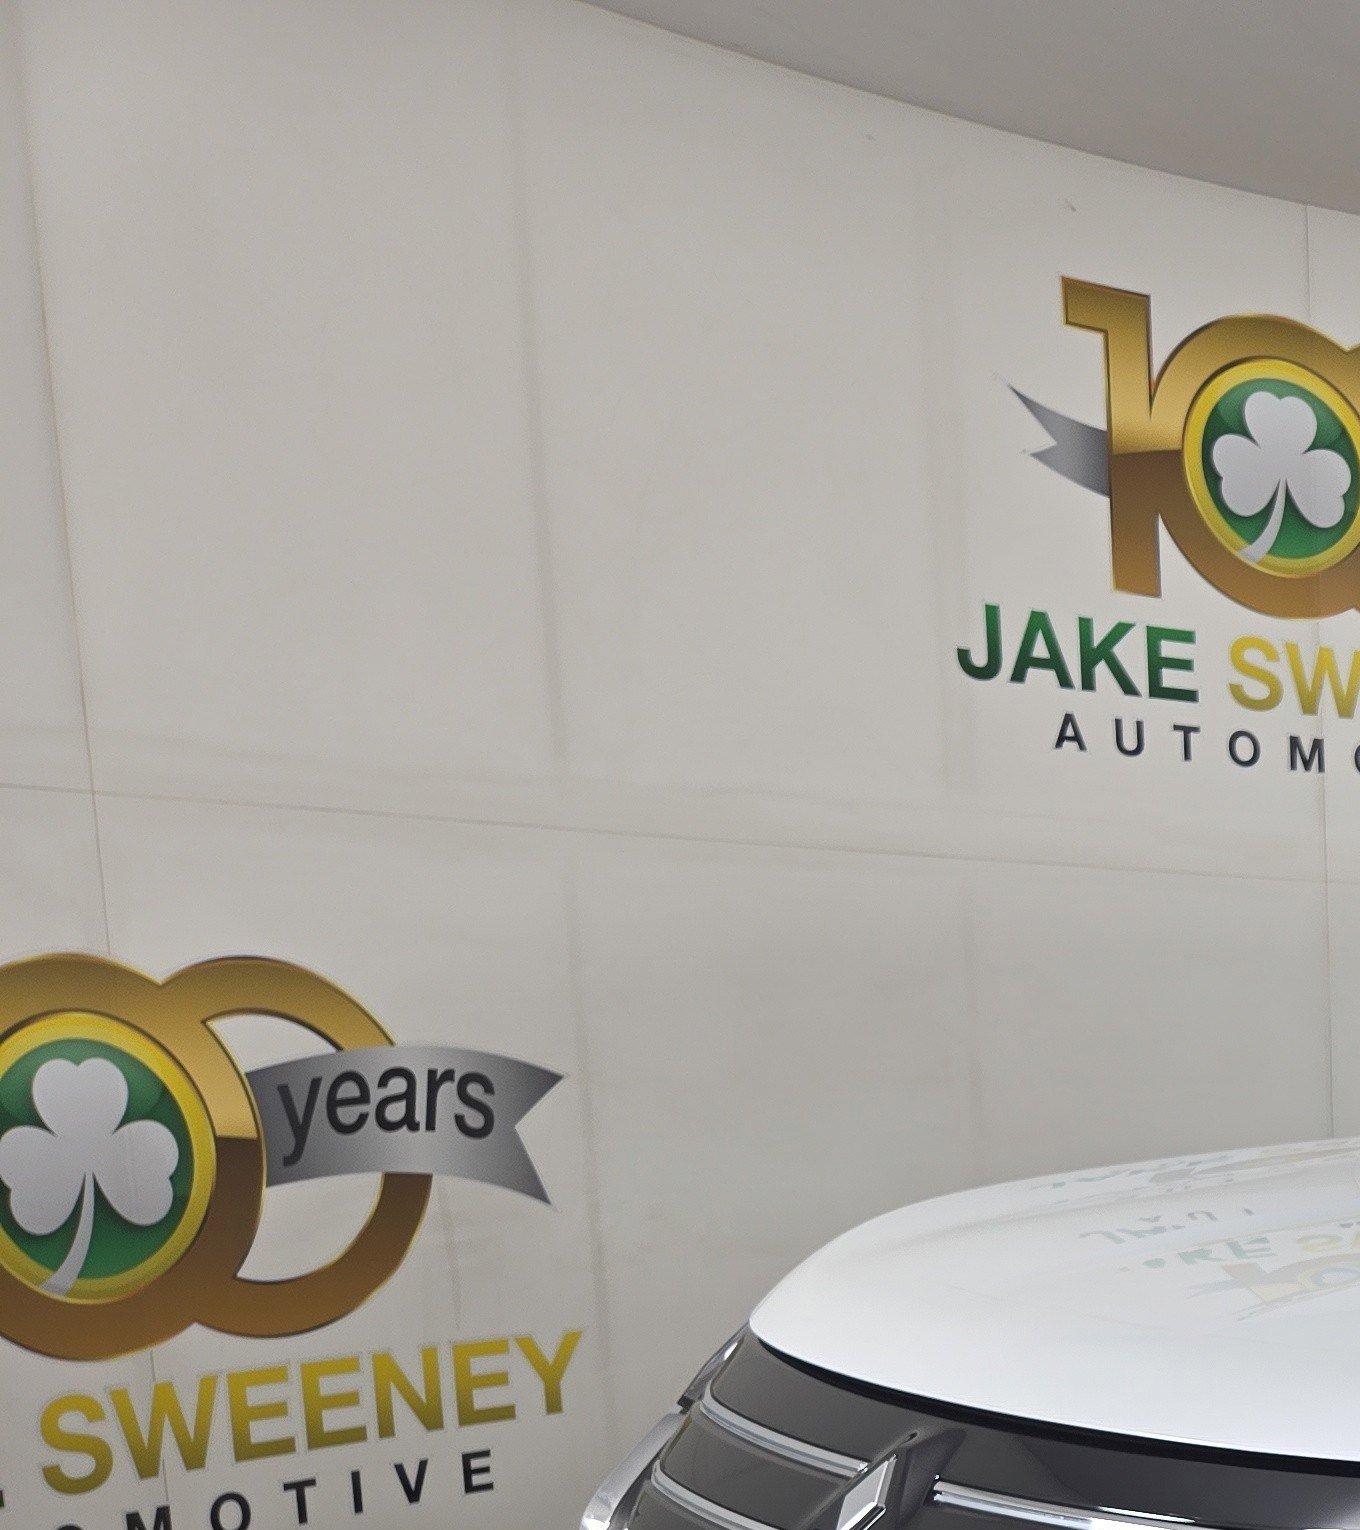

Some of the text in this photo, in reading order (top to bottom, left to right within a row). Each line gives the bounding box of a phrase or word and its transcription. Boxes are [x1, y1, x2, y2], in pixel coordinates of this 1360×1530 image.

[957, 603, 1199, 703] JAKE
[277, 1066, 497, 1166] years
[39, 1330, 584, 1495] SWEENEY
